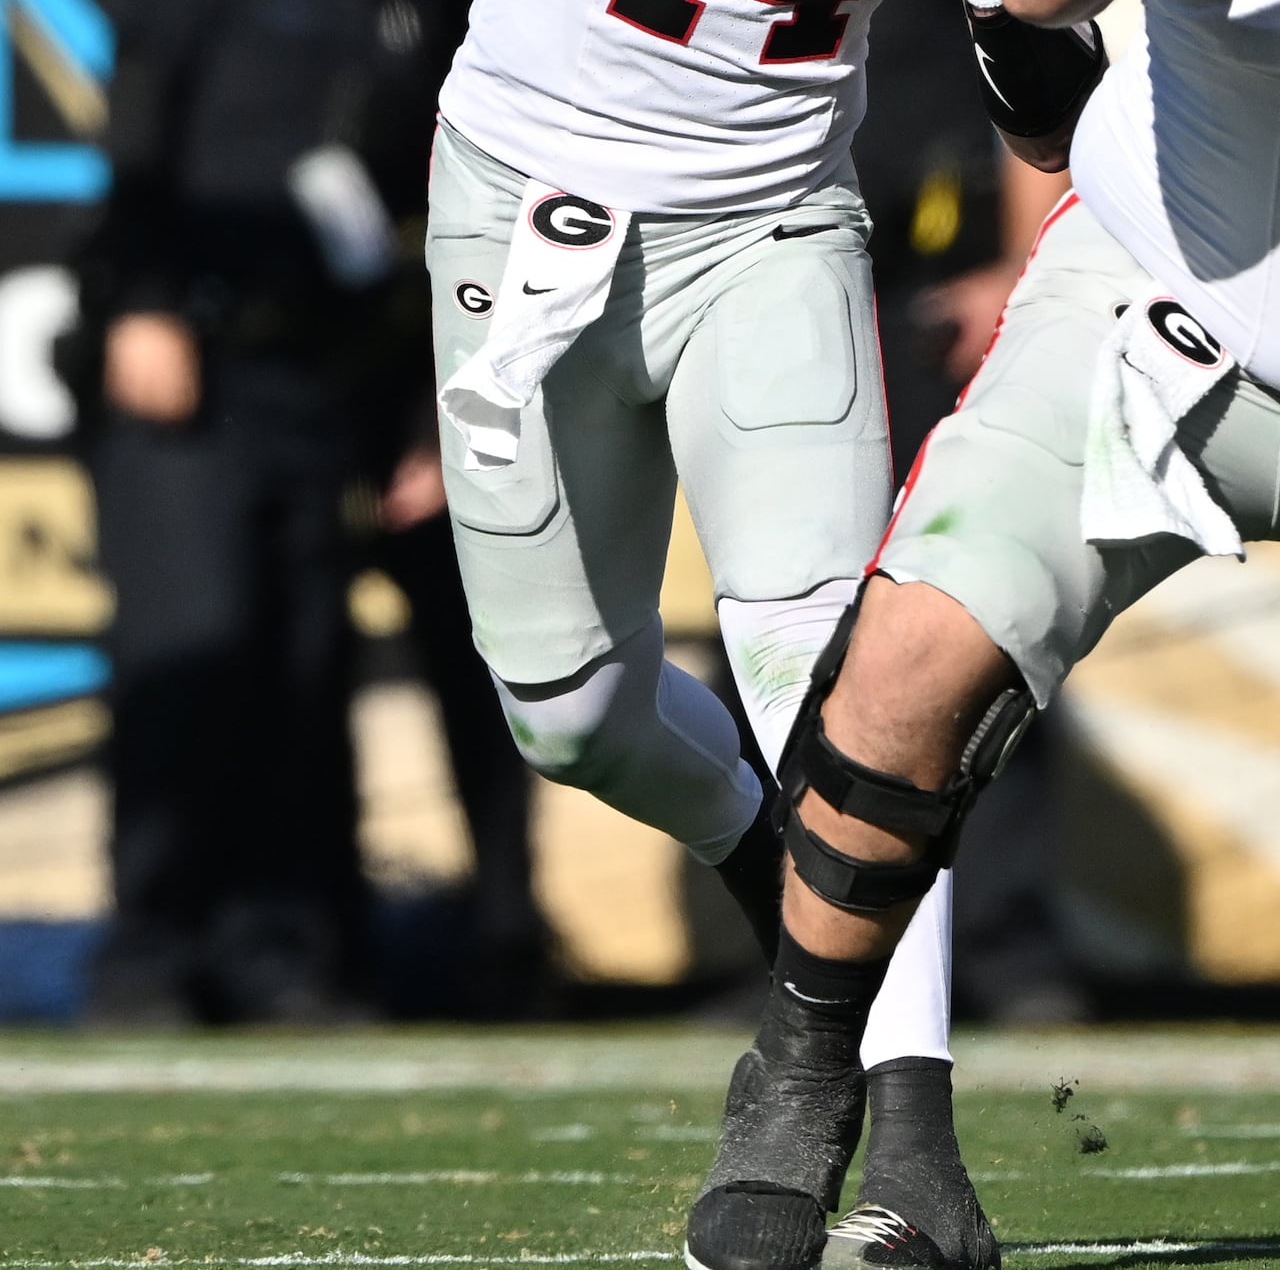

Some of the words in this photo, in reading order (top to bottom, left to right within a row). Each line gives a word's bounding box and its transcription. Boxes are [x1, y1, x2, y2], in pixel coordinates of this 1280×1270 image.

[527, 191, 617, 251] G
[453, 279, 494, 318] G
[1145, 296, 1226, 370] G
